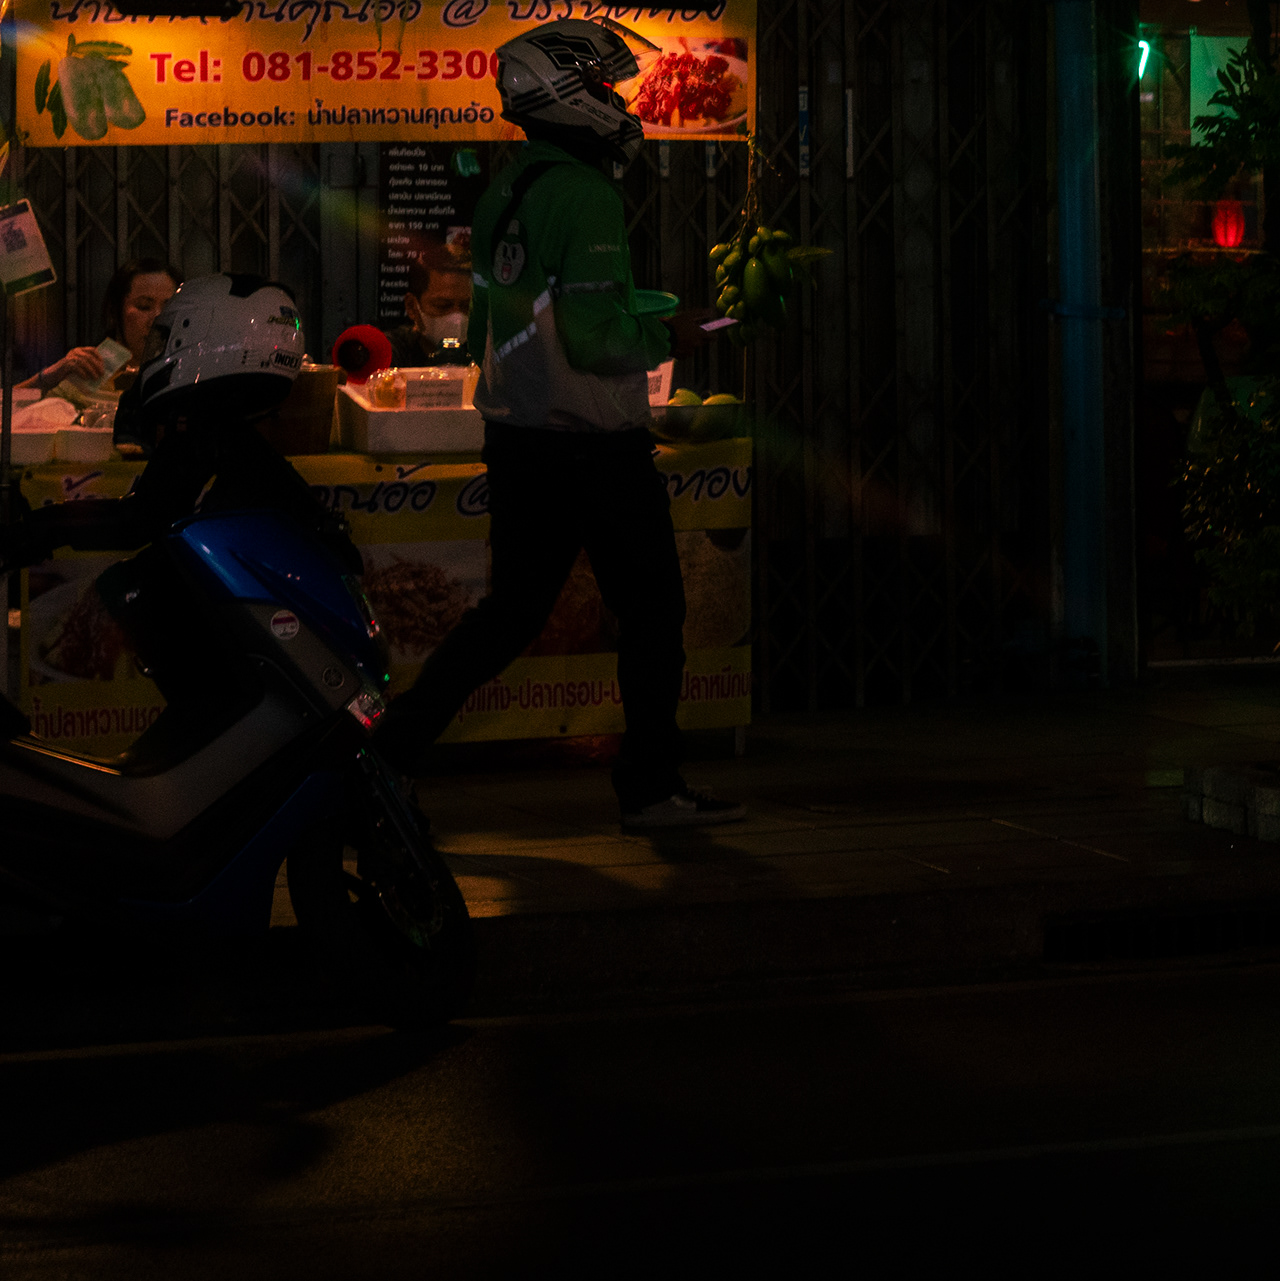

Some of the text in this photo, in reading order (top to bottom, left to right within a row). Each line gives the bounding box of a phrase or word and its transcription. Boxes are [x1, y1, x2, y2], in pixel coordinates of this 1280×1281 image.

[150, 51, 223, 83] Tel:
[165, 99, 495, 129] Facebook: น้ำปลาหวานคุณอ้อ
